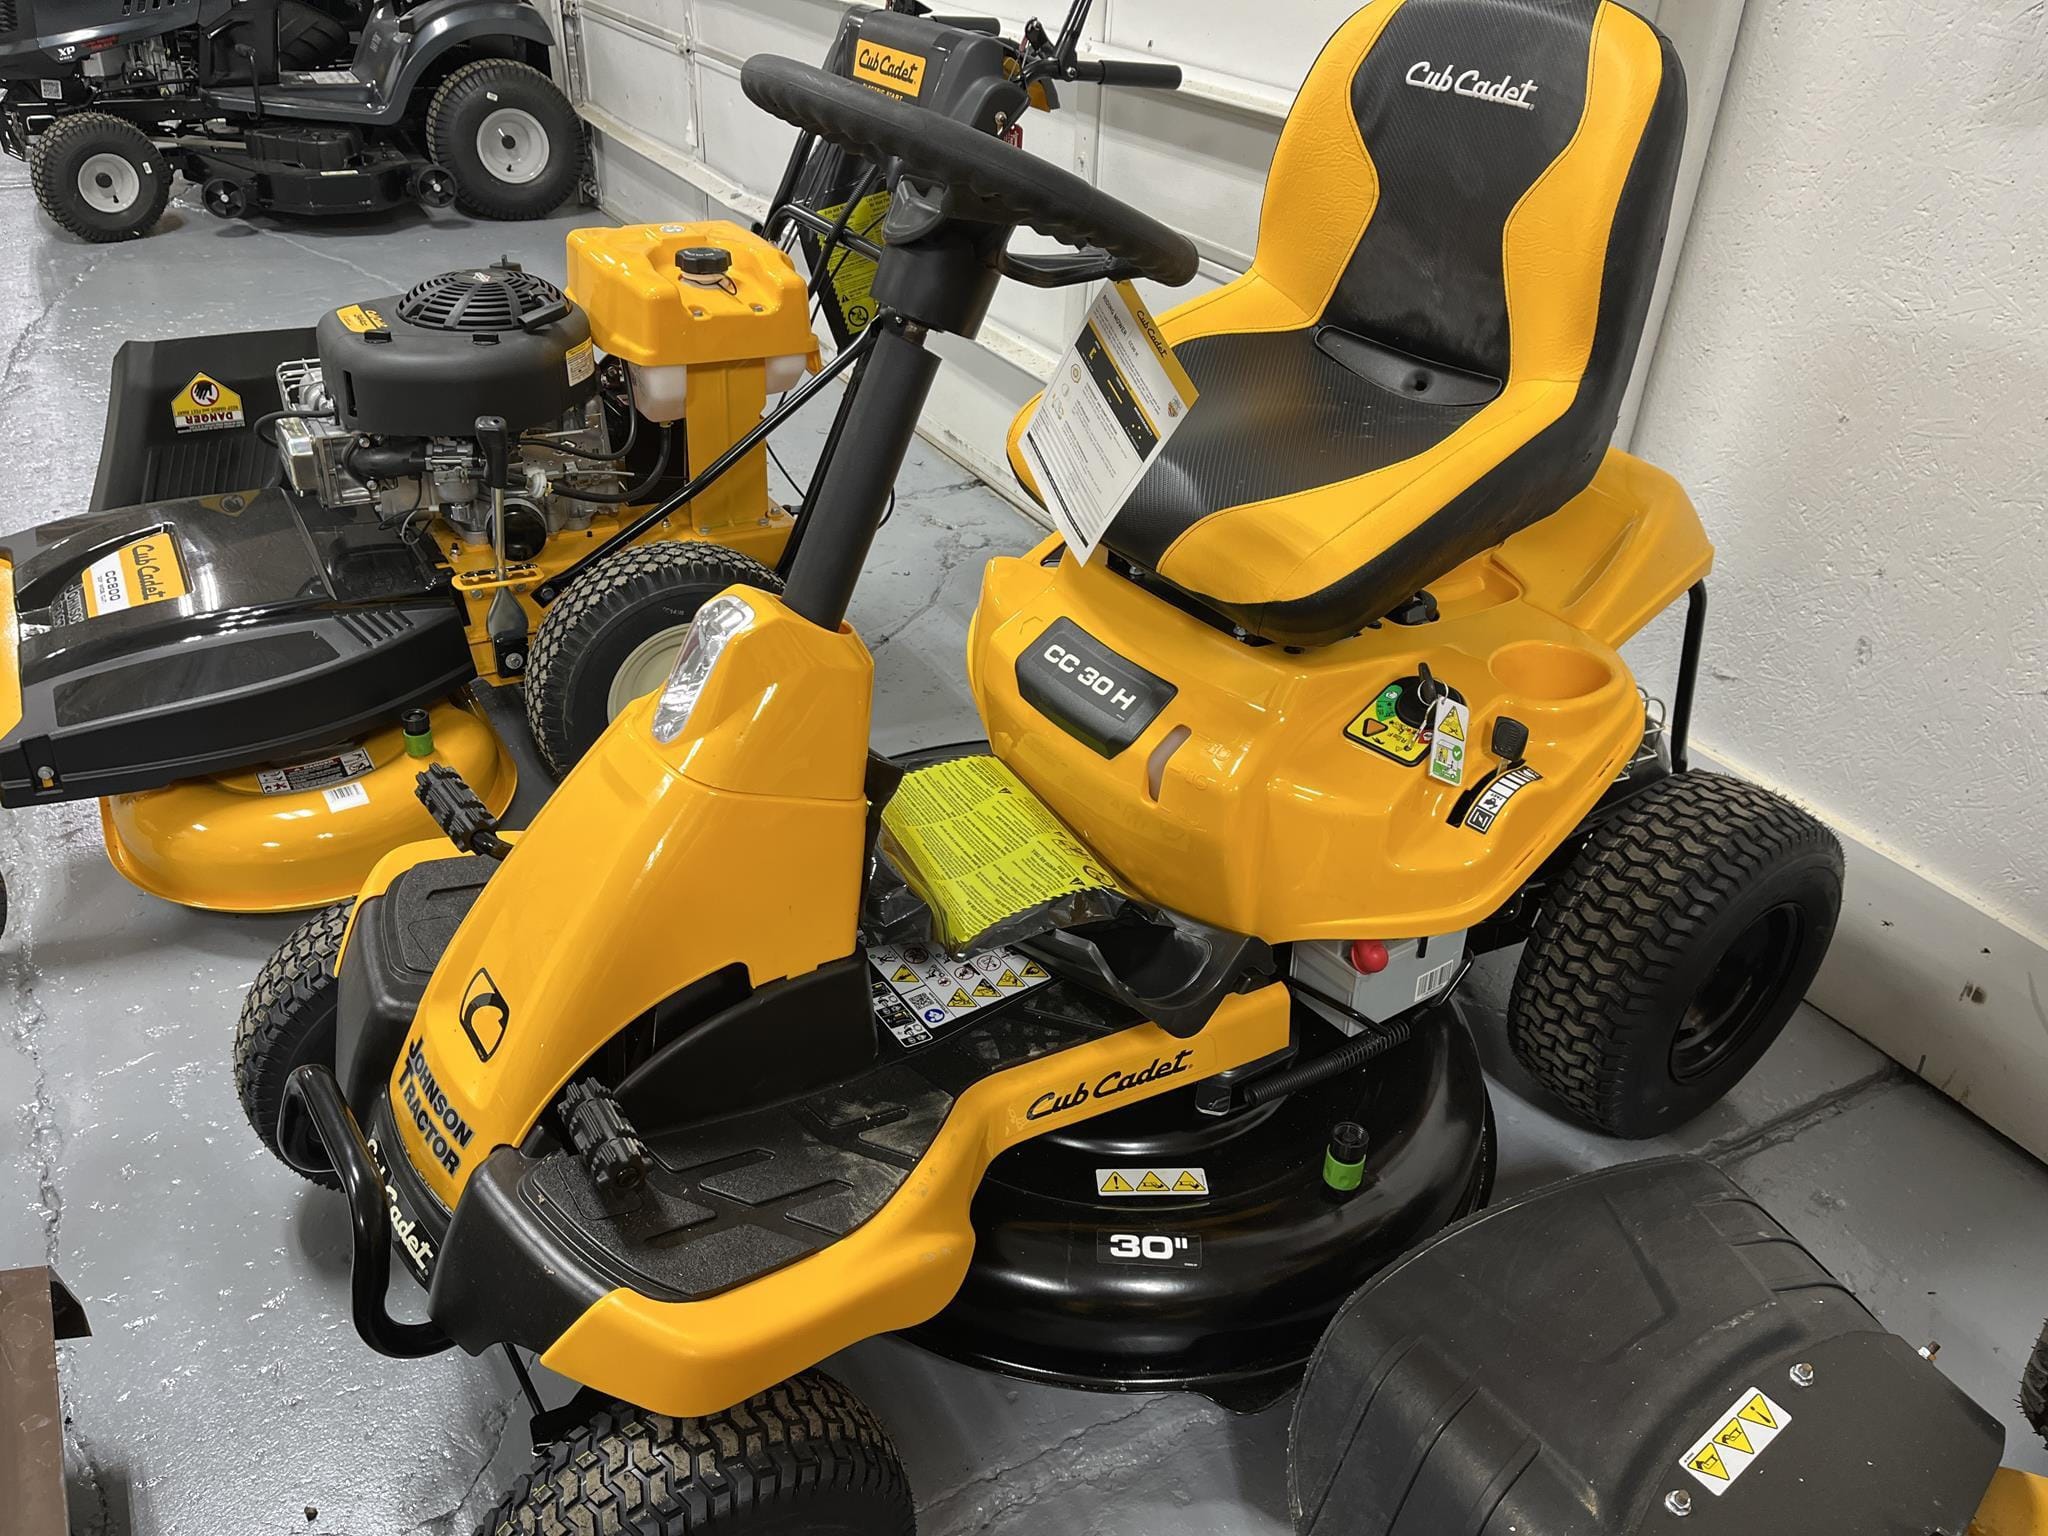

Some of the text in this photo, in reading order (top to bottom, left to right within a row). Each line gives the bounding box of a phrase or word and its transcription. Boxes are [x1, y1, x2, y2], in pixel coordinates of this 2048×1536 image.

[57, 45, 76, 56] XP
[858, 48, 918, 84] Cub Cadet
[1405, 61, 1538, 110] Cub Cadet
[1102, 294, 1115, 315] RIDING
[1113, 314, 1128, 337] MOWER
[1136, 310, 1168, 359] Cub Cadet
[185, 411, 233, 424] DANGER
[105, 570, 120, 602] CC800
[132, 544, 165, 600] Cub Cadet
[1043, 644, 1137, 711] CC 30 H
[409, 1036, 475, 1148] JOHNSON
[1026, 1049, 1193, 1120] Cub Cadet
[399, 1056, 461, 1176] TRACTOR
[1110, 1234, 1188, 1260] 30"
